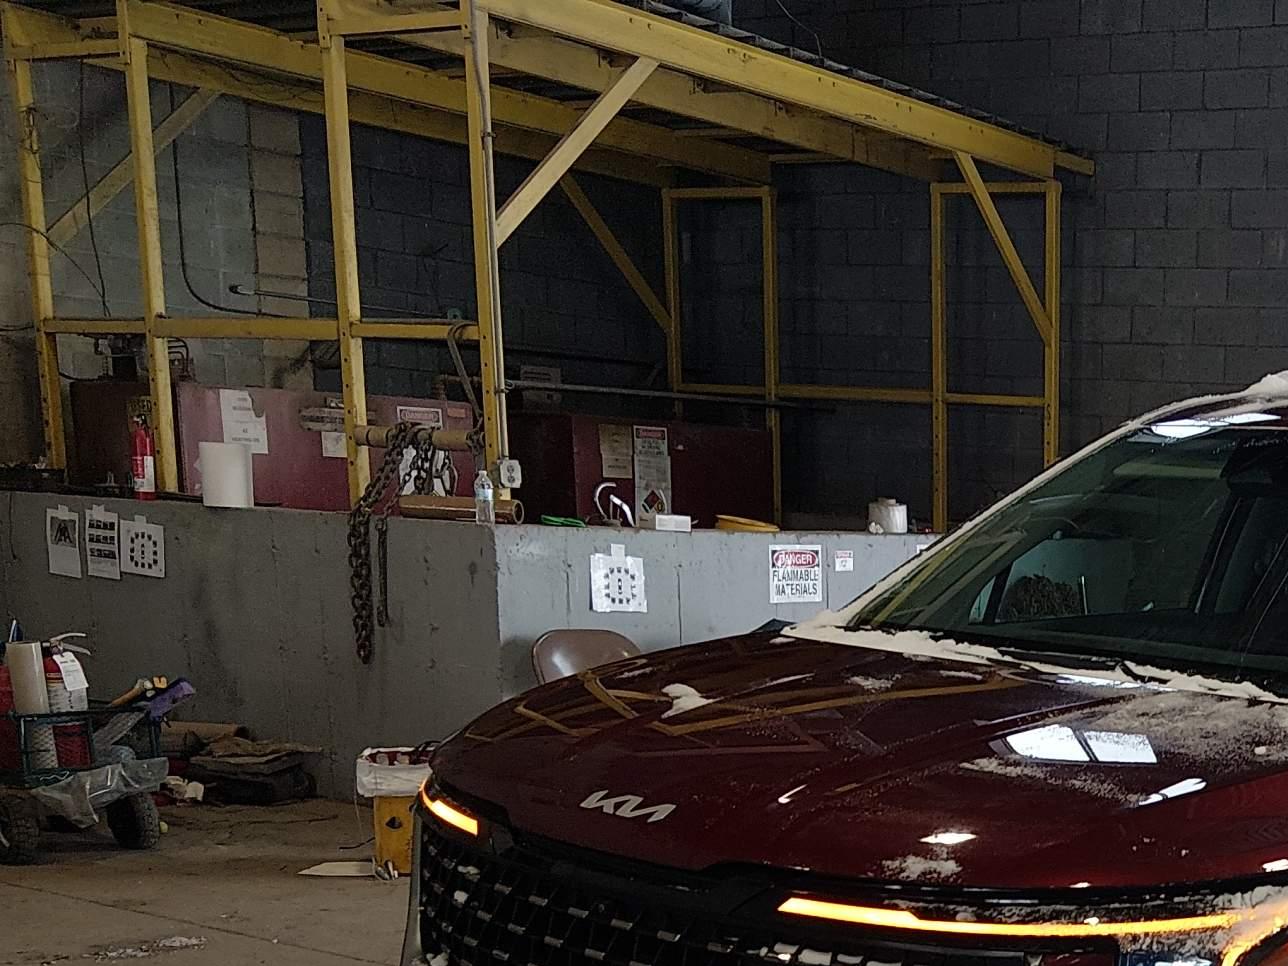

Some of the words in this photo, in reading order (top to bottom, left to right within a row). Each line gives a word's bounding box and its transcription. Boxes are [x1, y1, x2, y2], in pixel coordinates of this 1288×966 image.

[778, 552, 813, 566] DANGER
[772, 569, 819, 582] FLAMMABLE
[775, 583, 818, 596] MATERIALS
